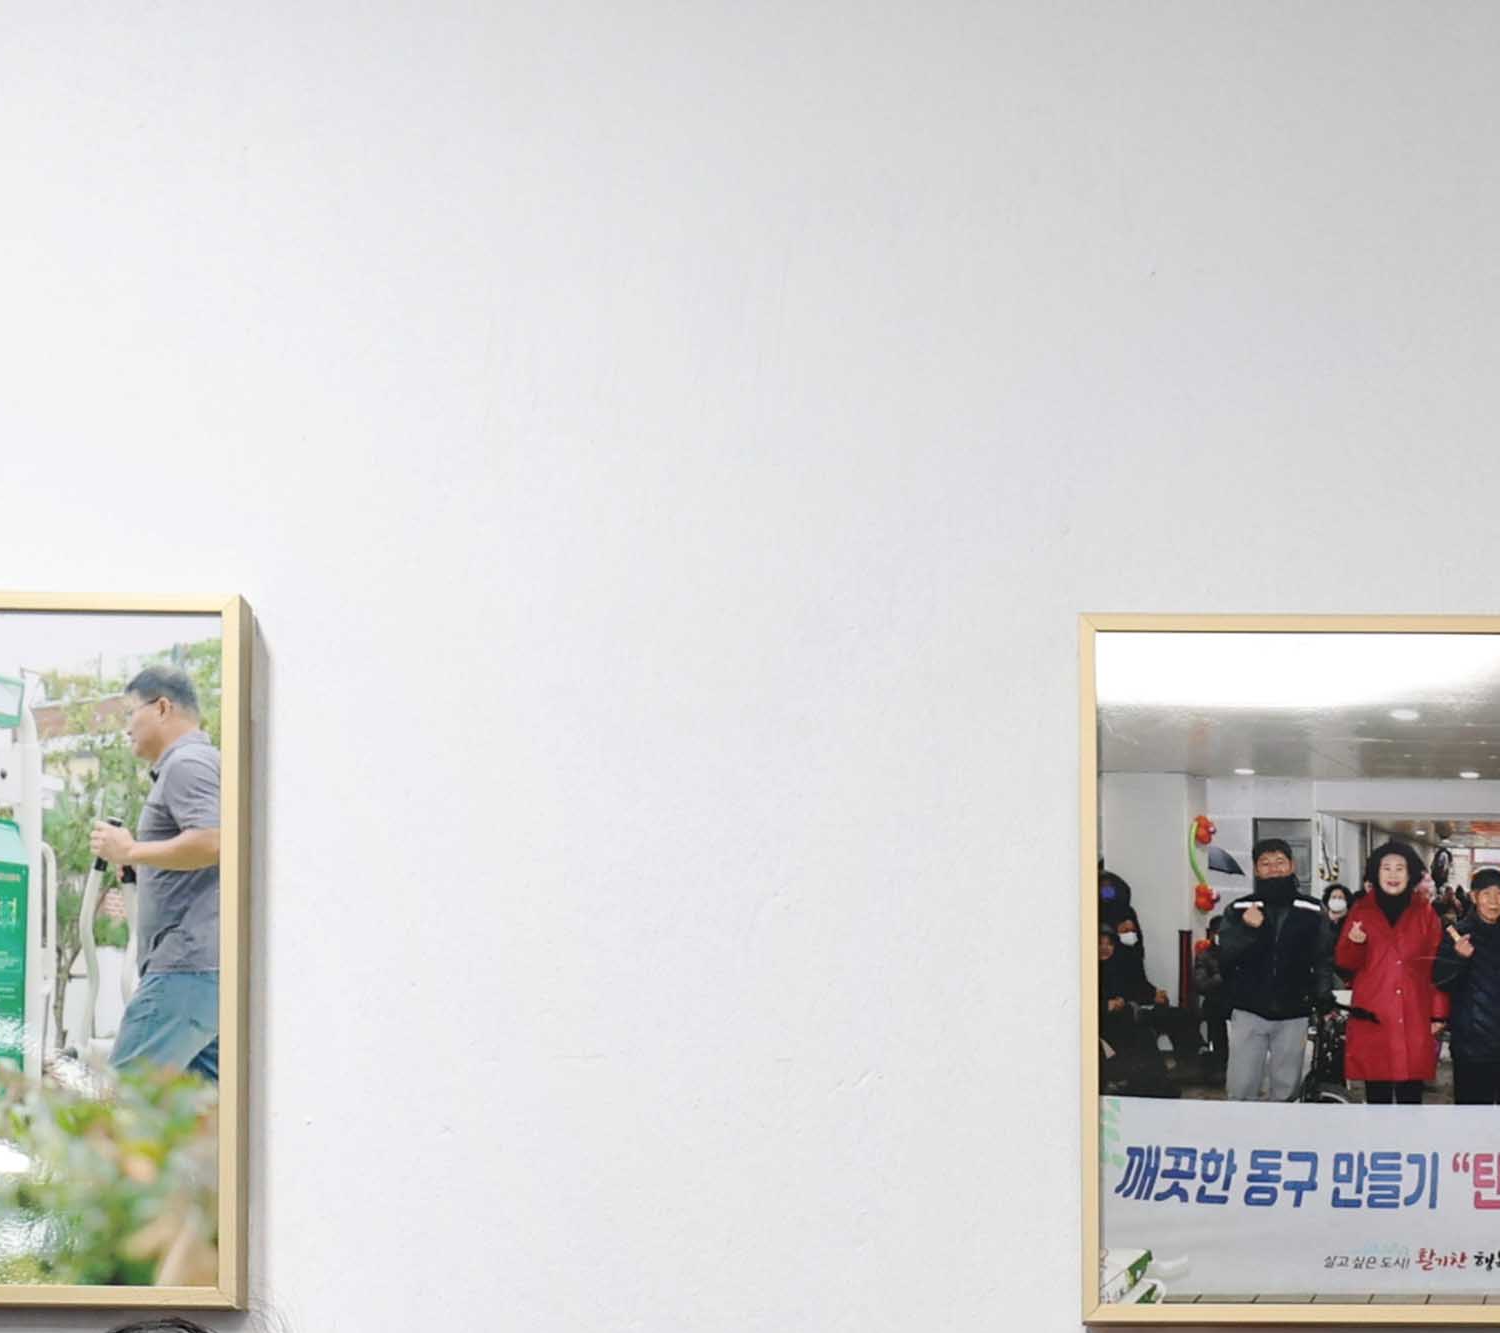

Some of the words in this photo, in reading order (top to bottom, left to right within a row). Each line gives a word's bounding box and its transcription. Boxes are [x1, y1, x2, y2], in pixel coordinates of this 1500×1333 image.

[1114, 1145, 1238, 1205] 깨끗한
[1243, 1149, 1319, 1208] 동구
[1331, 1151, 1440, 1210] 만들기
[1415, 1247, 1468, 1271] 활기찬
